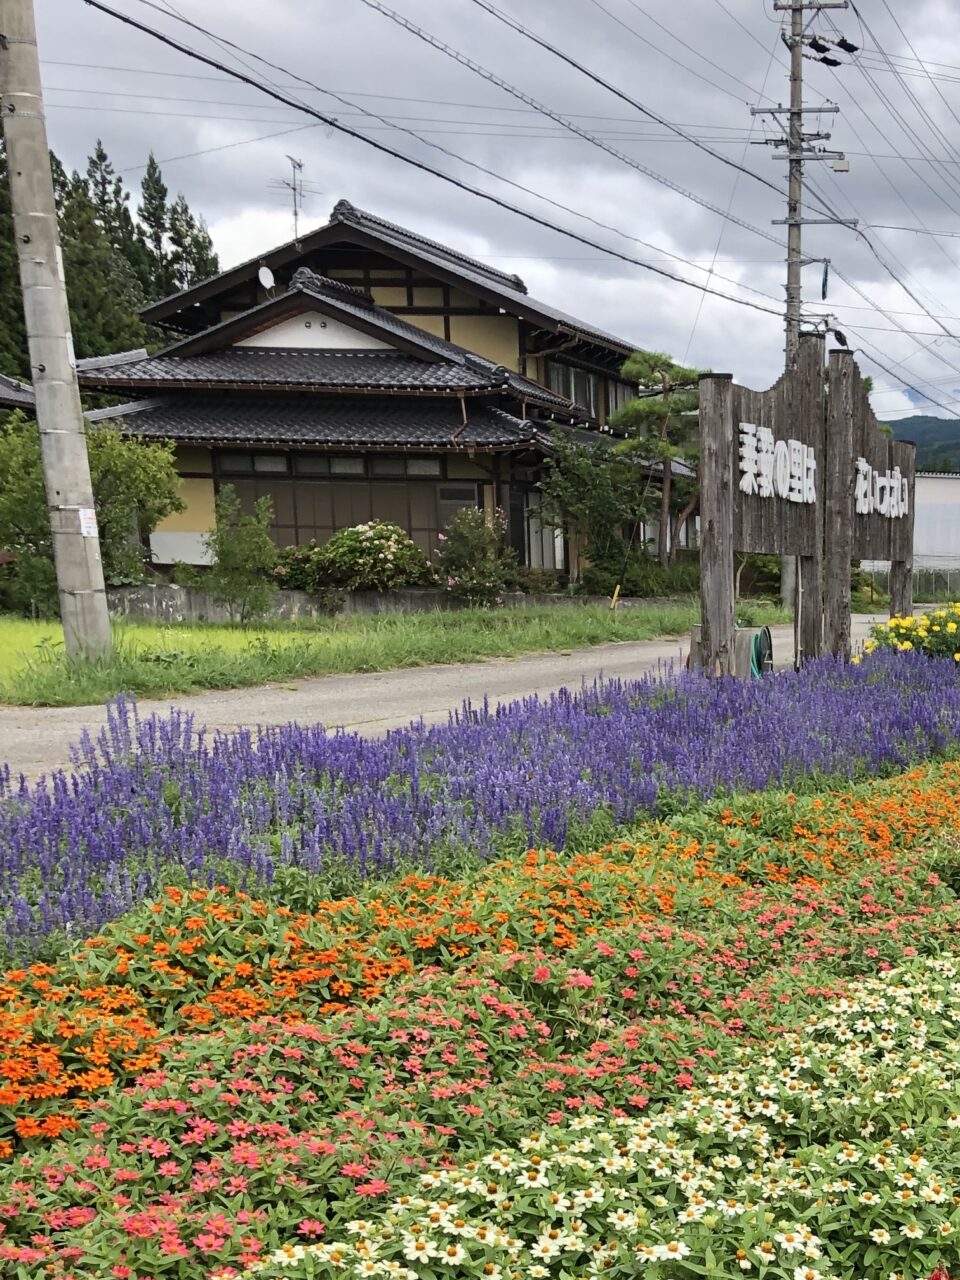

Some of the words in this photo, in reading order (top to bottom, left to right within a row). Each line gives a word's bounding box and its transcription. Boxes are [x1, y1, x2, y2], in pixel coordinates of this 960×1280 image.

[854, 456, 909, 519] 花いっぱい
